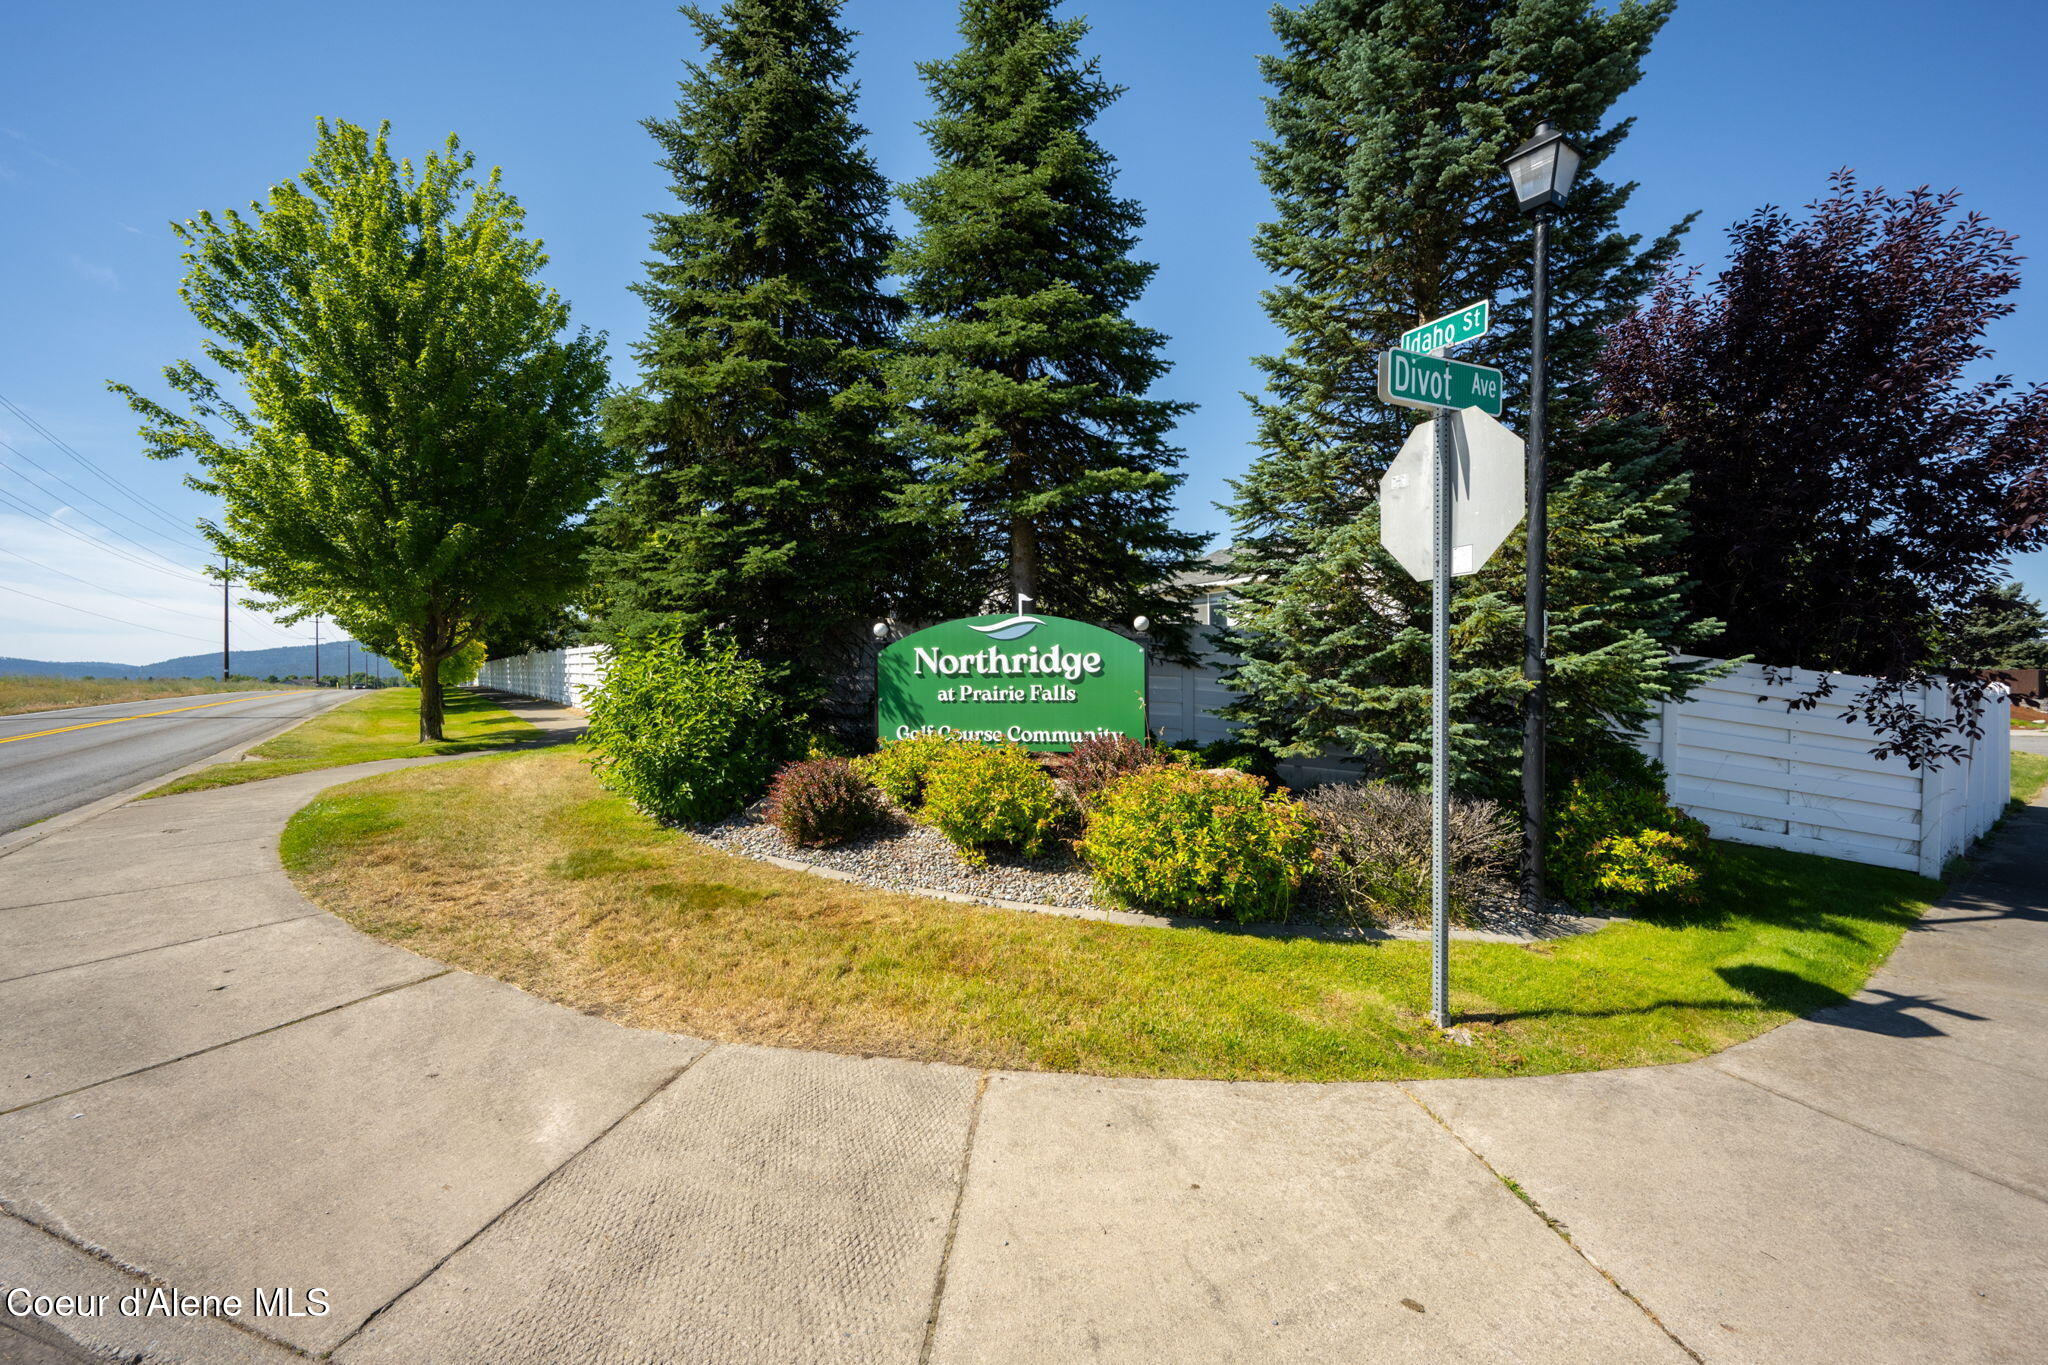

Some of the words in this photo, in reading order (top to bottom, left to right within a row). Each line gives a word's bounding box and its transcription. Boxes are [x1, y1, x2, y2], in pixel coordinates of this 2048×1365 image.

[1405, 324, 1455, 352] Idaho
[1463, 309, 1480, 331] St
[1395, 355, 1452, 400] Divot
[1471, 372, 1497, 399] Ave
[913, 644, 1101, 680] Northridge
[937, 687, 955, 701] at
[959, 685, 1025, 701] Prairie
[1029, 684, 1076, 701] Falls
